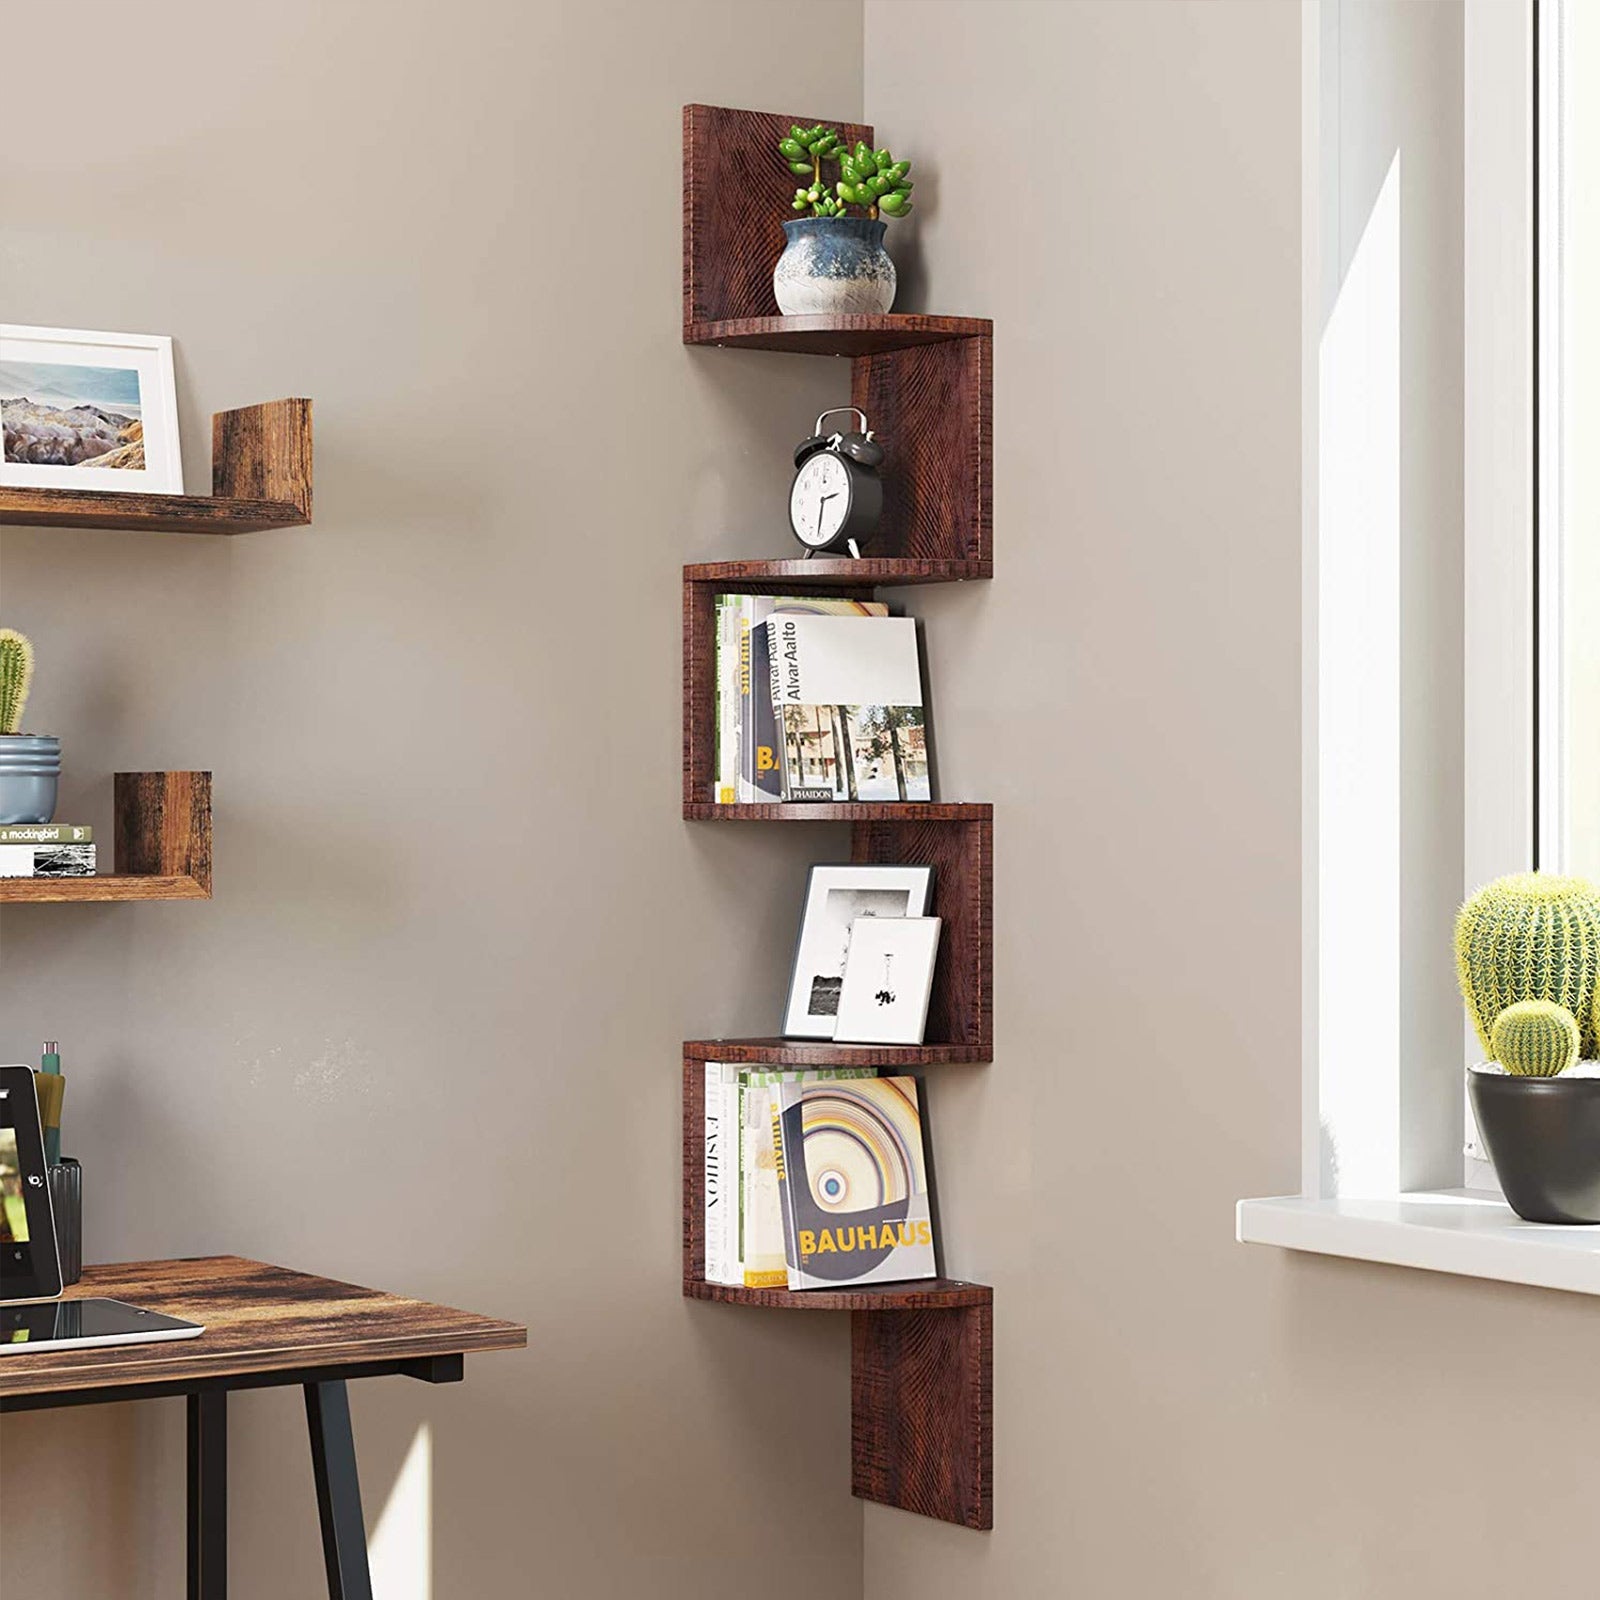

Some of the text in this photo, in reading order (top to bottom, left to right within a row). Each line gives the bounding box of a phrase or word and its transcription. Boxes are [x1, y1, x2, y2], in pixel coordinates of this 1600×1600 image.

[782, 621, 801, 701] Alvar Aalto
[793, 787, 832, 799] PHAIDON
[8, 827, 60, 842] mockingbird
[706, 1116, 719, 1208] FASHION
[799, 1220, 931, 1255] BAUHAUS
